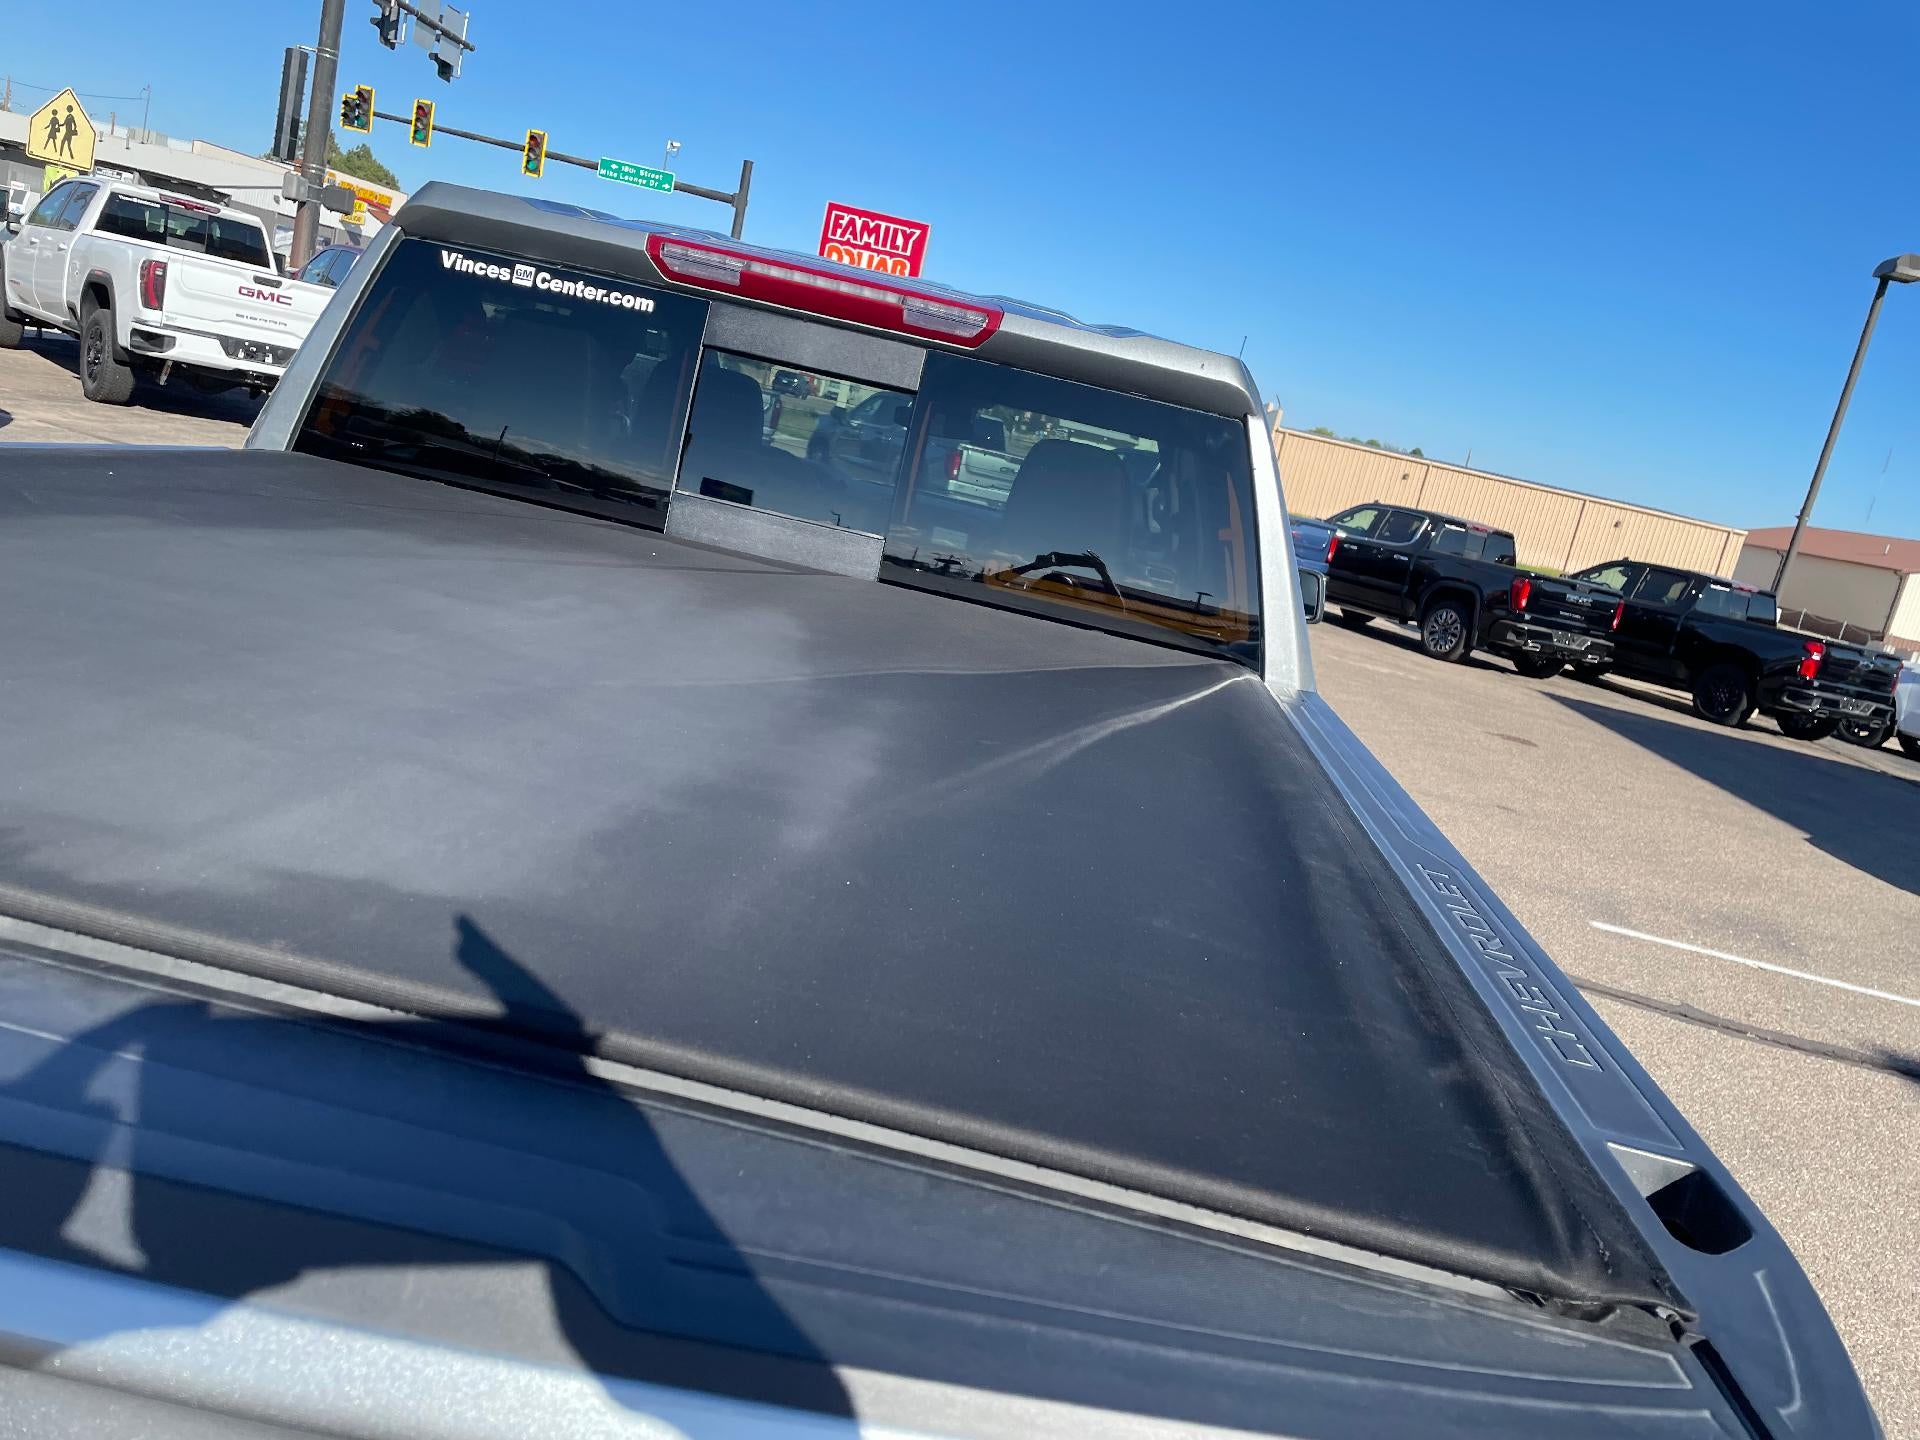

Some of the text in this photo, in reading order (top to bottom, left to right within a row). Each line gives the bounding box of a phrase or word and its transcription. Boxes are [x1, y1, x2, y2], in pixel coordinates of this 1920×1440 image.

[600, 168, 618, 178] Mike
[649, 179, 659, 188] Dr
[639, 169, 663, 181] Street
[828, 210, 922, 256] FAMILY
[441, 249, 655, 313] Vinces GM Center.com
[239, 285, 292, 306] GMC
